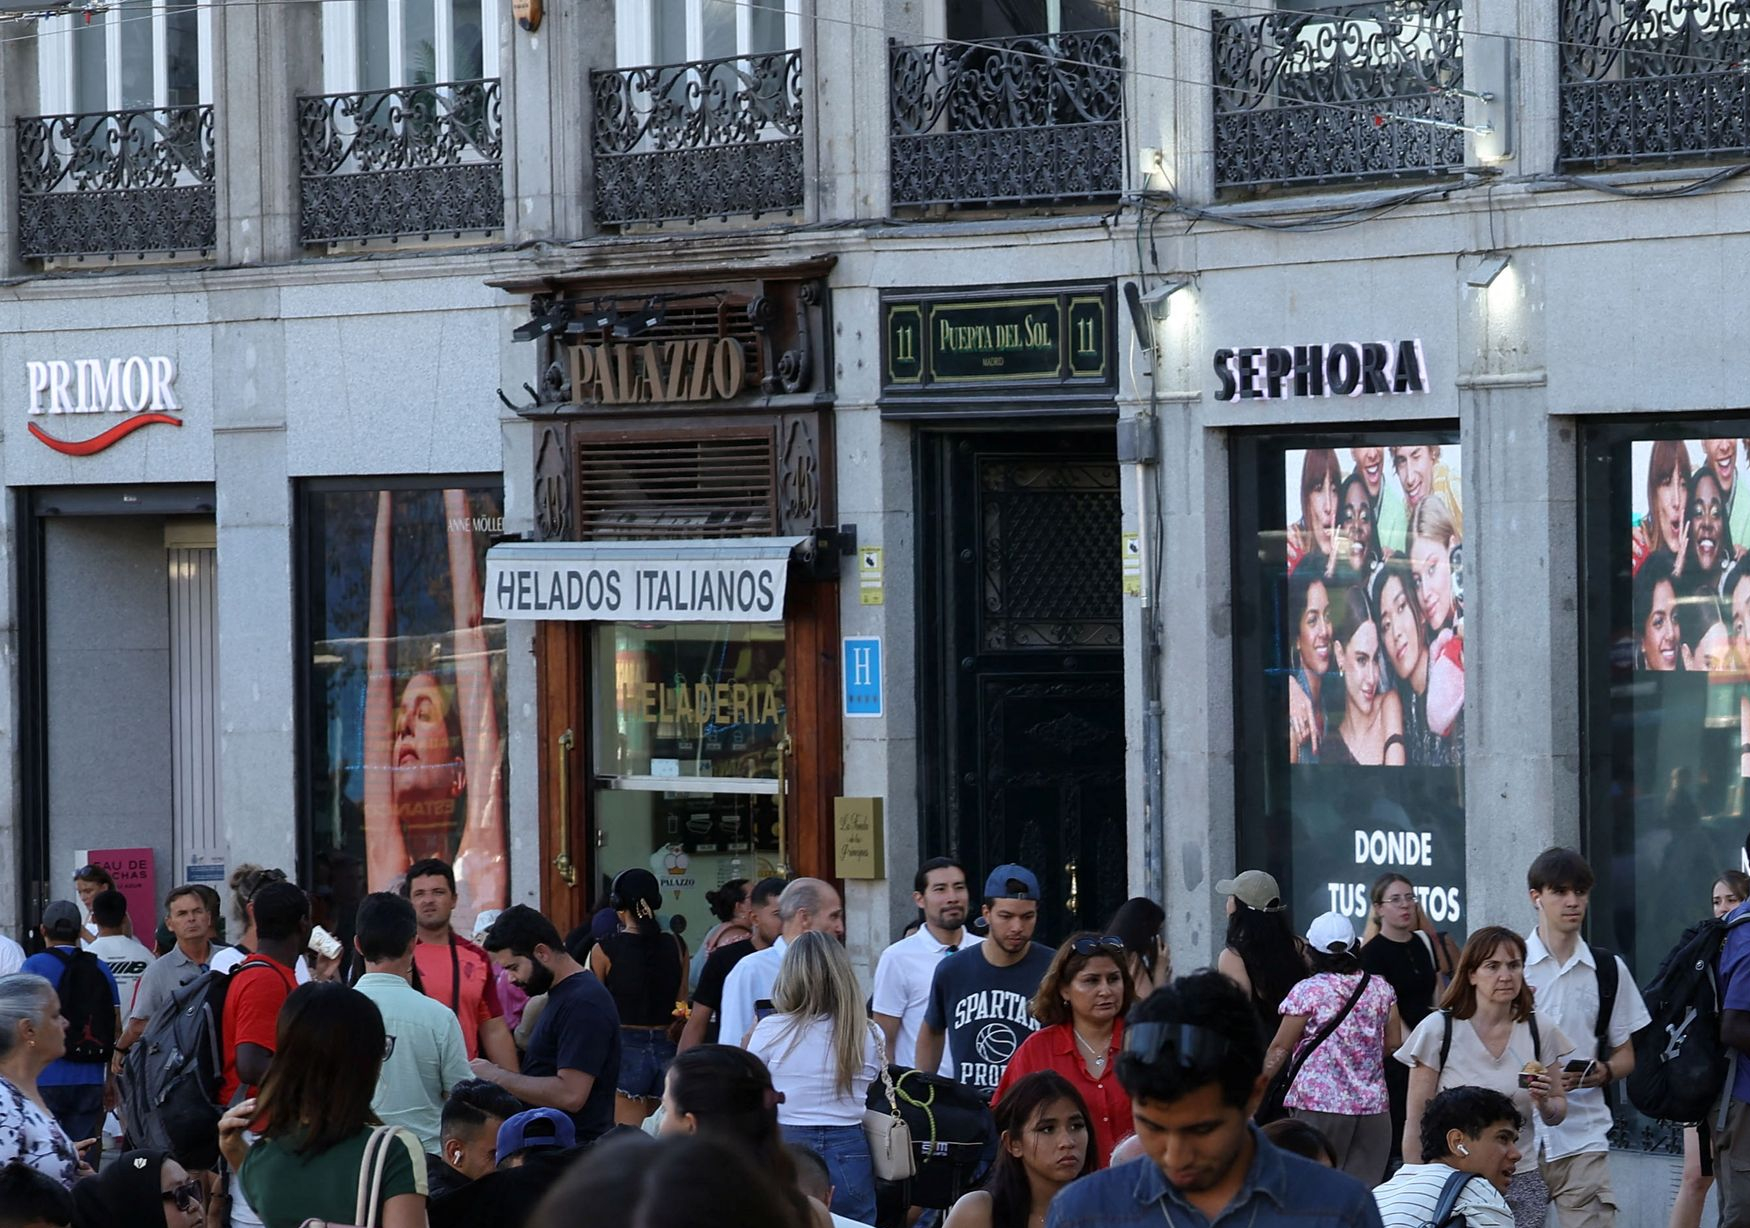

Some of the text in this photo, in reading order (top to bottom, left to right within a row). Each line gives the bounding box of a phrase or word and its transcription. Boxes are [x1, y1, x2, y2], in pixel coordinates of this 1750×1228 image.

[896, 325, 913, 361] 11
[1077, 318, 1095, 353] 11
[26, 356, 182, 415] PRIMOR
[569, 336, 746, 405] PALAZZO
[1213, 339, 1429, 403] SEPHORA
[447, 517, 471, 533] ANNE
[497, 569, 774, 613] HELADOS ITALIANOS
[852, 646, 872, 686] H
[622, 681, 780, 725] HELADERIA
[128, 859, 148, 871] DE
[1354, 829, 1433, 867] DONDE
[111, 871, 148, 880] CHAS
[660, 878, 696, 888] PALAZZO
[1328, 882, 1368, 918] TUS
[960, 1062, 1007, 1087] PRO
